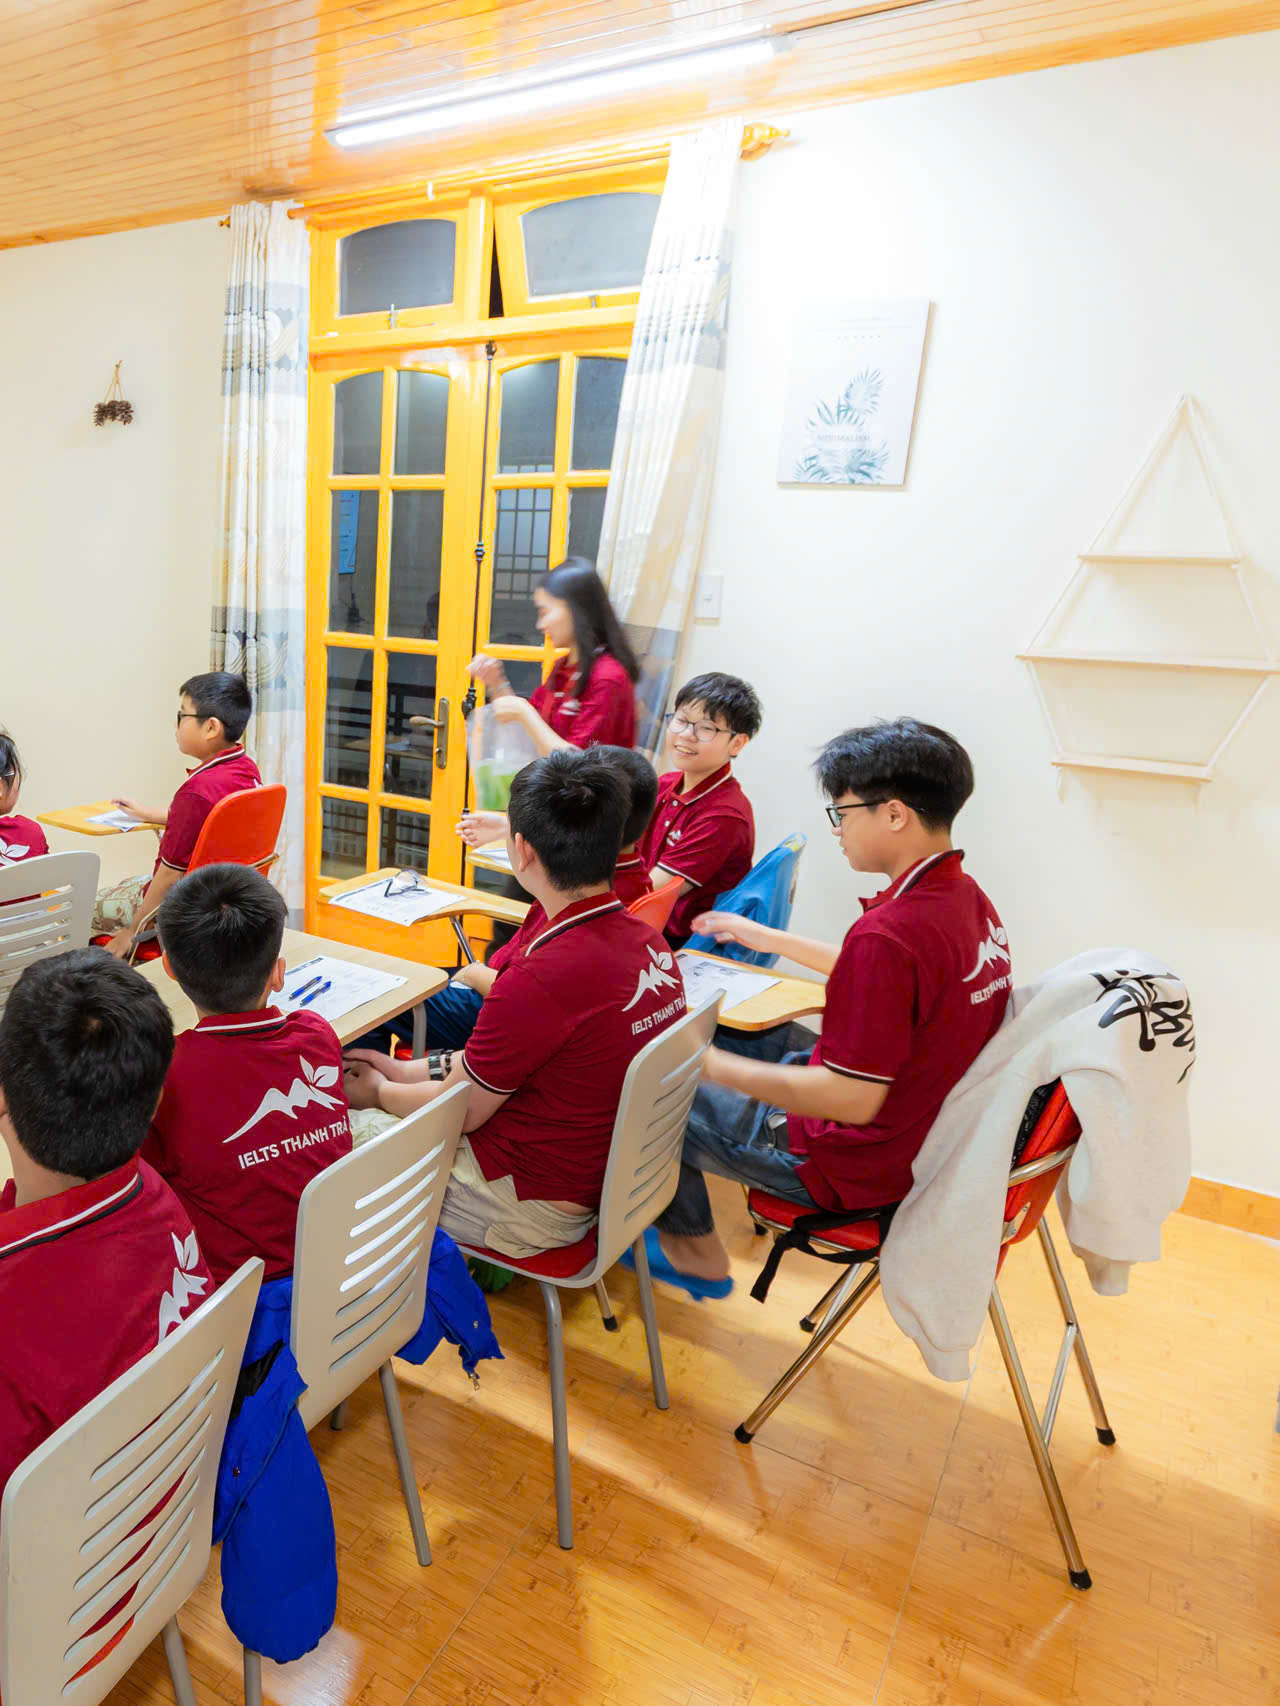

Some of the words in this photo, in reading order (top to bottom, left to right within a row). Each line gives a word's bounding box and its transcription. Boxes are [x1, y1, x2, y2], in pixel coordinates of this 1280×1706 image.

[631, 1015, 653, 1036] IELTS
[652, 1002, 675, 1025] THANH
[238, 1144, 280, 1169] IELTS
[281, 1126, 330, 1154] THANH
[329, 1115, 349, 1138] TRÀ
